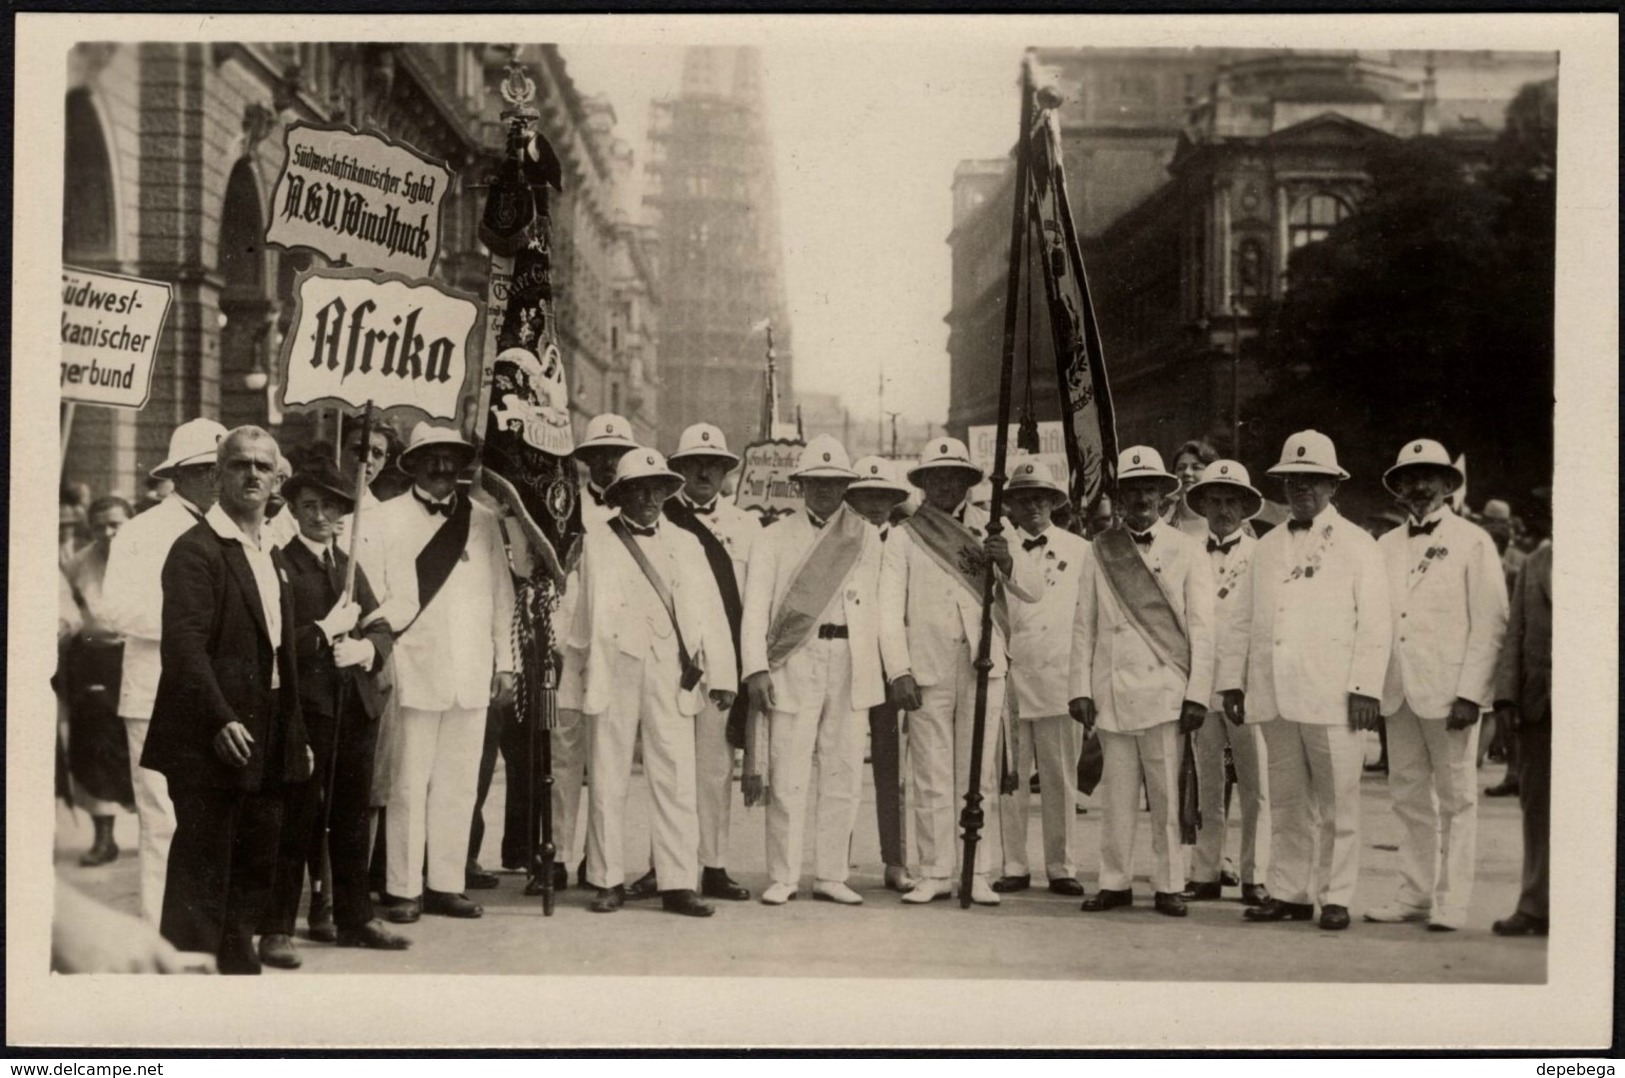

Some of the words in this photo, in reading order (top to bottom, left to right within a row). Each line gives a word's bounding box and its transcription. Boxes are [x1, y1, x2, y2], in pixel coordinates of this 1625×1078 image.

[292, 143, 402, 196] Südwestafrikanischer
[401, 170, 436, 205] Sgbd.
[61, 274, 142, 315] üdwest-
[309, 295, 456, 386] Afrika
